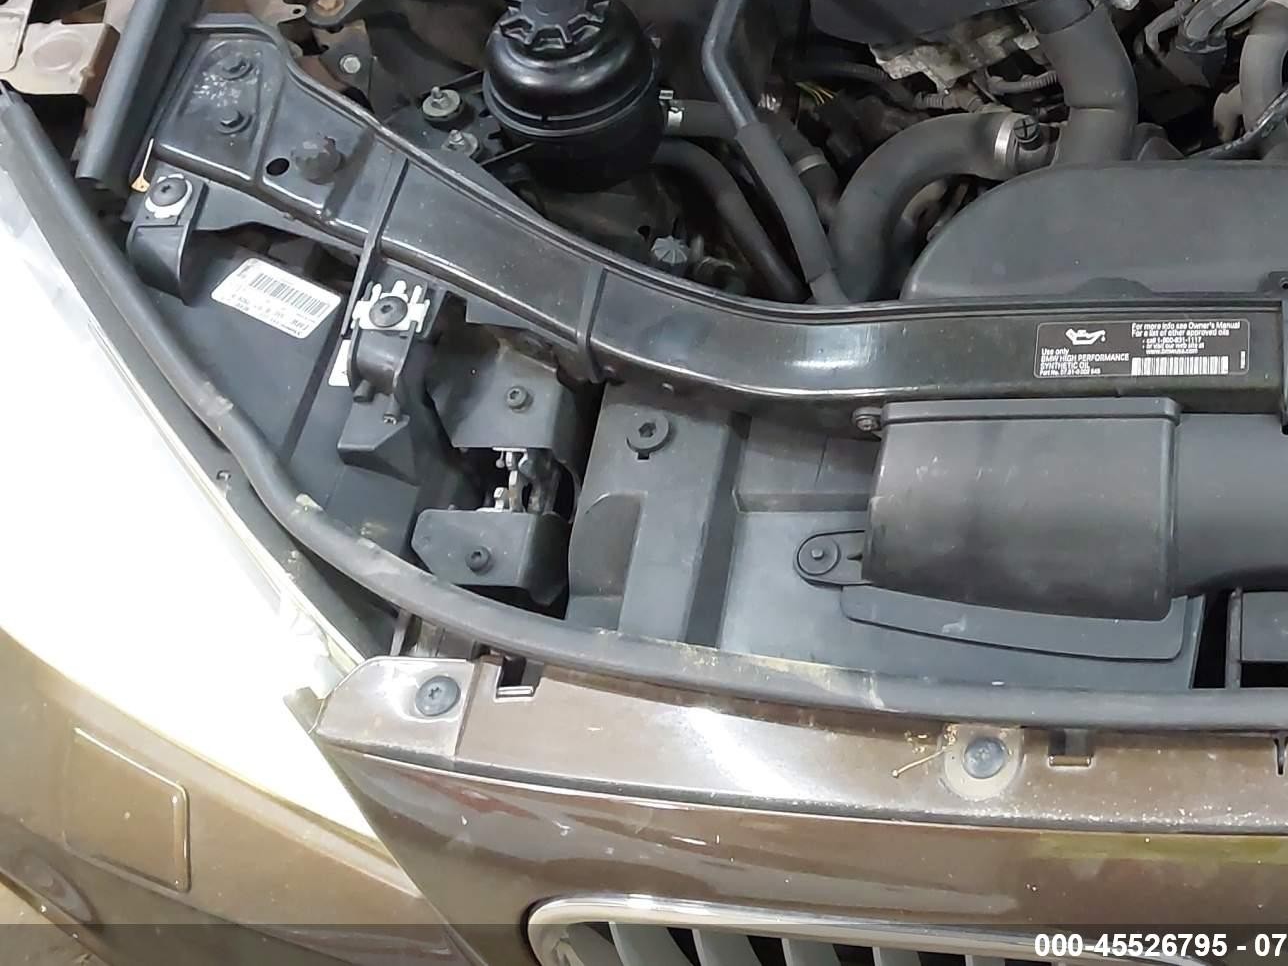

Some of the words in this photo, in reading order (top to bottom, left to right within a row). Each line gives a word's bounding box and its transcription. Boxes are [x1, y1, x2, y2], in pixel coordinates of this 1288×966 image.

[1132, 322, 1143, 330] For
[1188, 321, 1215, 329] Owner's
[1216, 321, 1240, 329] Manual
[1060, 354, 1077, 362] HIGH
[1078, 353, 1129, 361] PERFORMANCE
[1079, 361, 1090, 369] OIL
